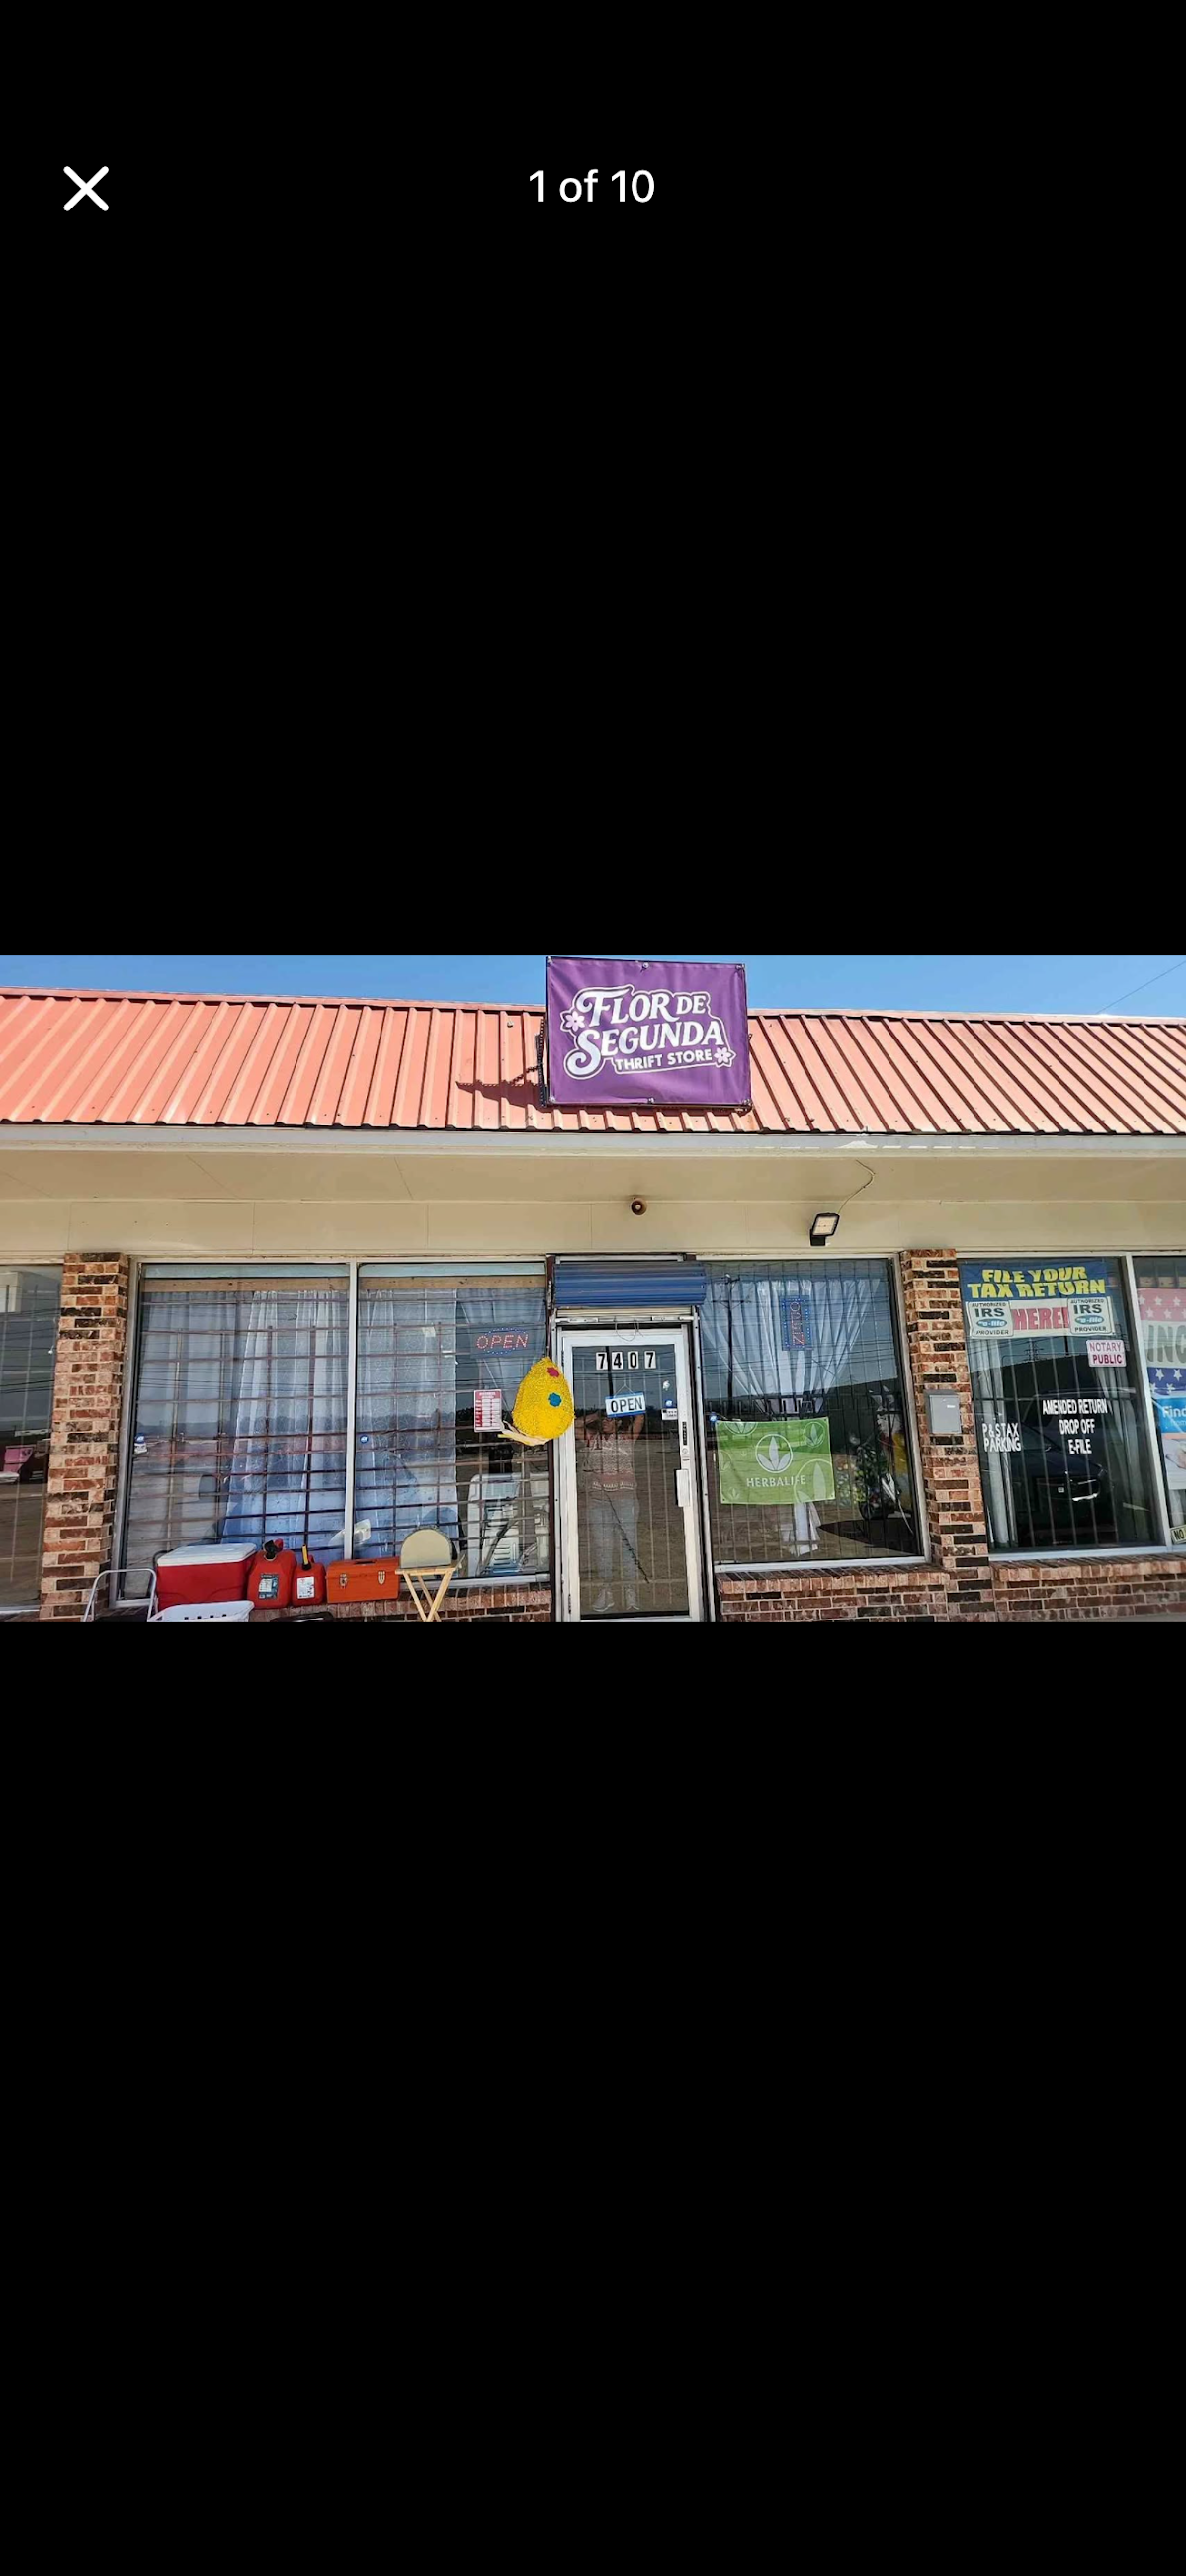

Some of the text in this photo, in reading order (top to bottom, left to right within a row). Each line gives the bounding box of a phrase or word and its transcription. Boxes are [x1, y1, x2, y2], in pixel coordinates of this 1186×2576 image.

[575, 988, 707, 1027] FLOR DE
[565, 1021, 724, 1076] SEGUNDA
[615, 1048, 713, 1071] THRIFT STORE
[981, 1266, 1087, 1283] FILE YOUR
[967, 1279, 1106, 1298] TAX RETURN
[974, 1308, 1005, 1317] IRS
[1073, 1304, 1103, 1314] IRS
[475, 1334, 529, 1350] OPEN
[1090, 1342, 1122, 1352] NOTARY
[1092, 1354, 1123, 1364] PUBLIC
[610, 1396, 643, 1413] OPEN
[1042, 1398, 1108, 1415] AMENDED RETURN
[1000, 1423, 1020, 1438] TAX
[1059, 1418, 1095, 1435] DROP OFF
[983, 1437, 1022, 1452] PARKING
[1068, 1438, 1092, 1454] E-FILE
[746, 1475, 806, 1487] HERBALIFE
[1173, 1529, 1185, 1540] NO
